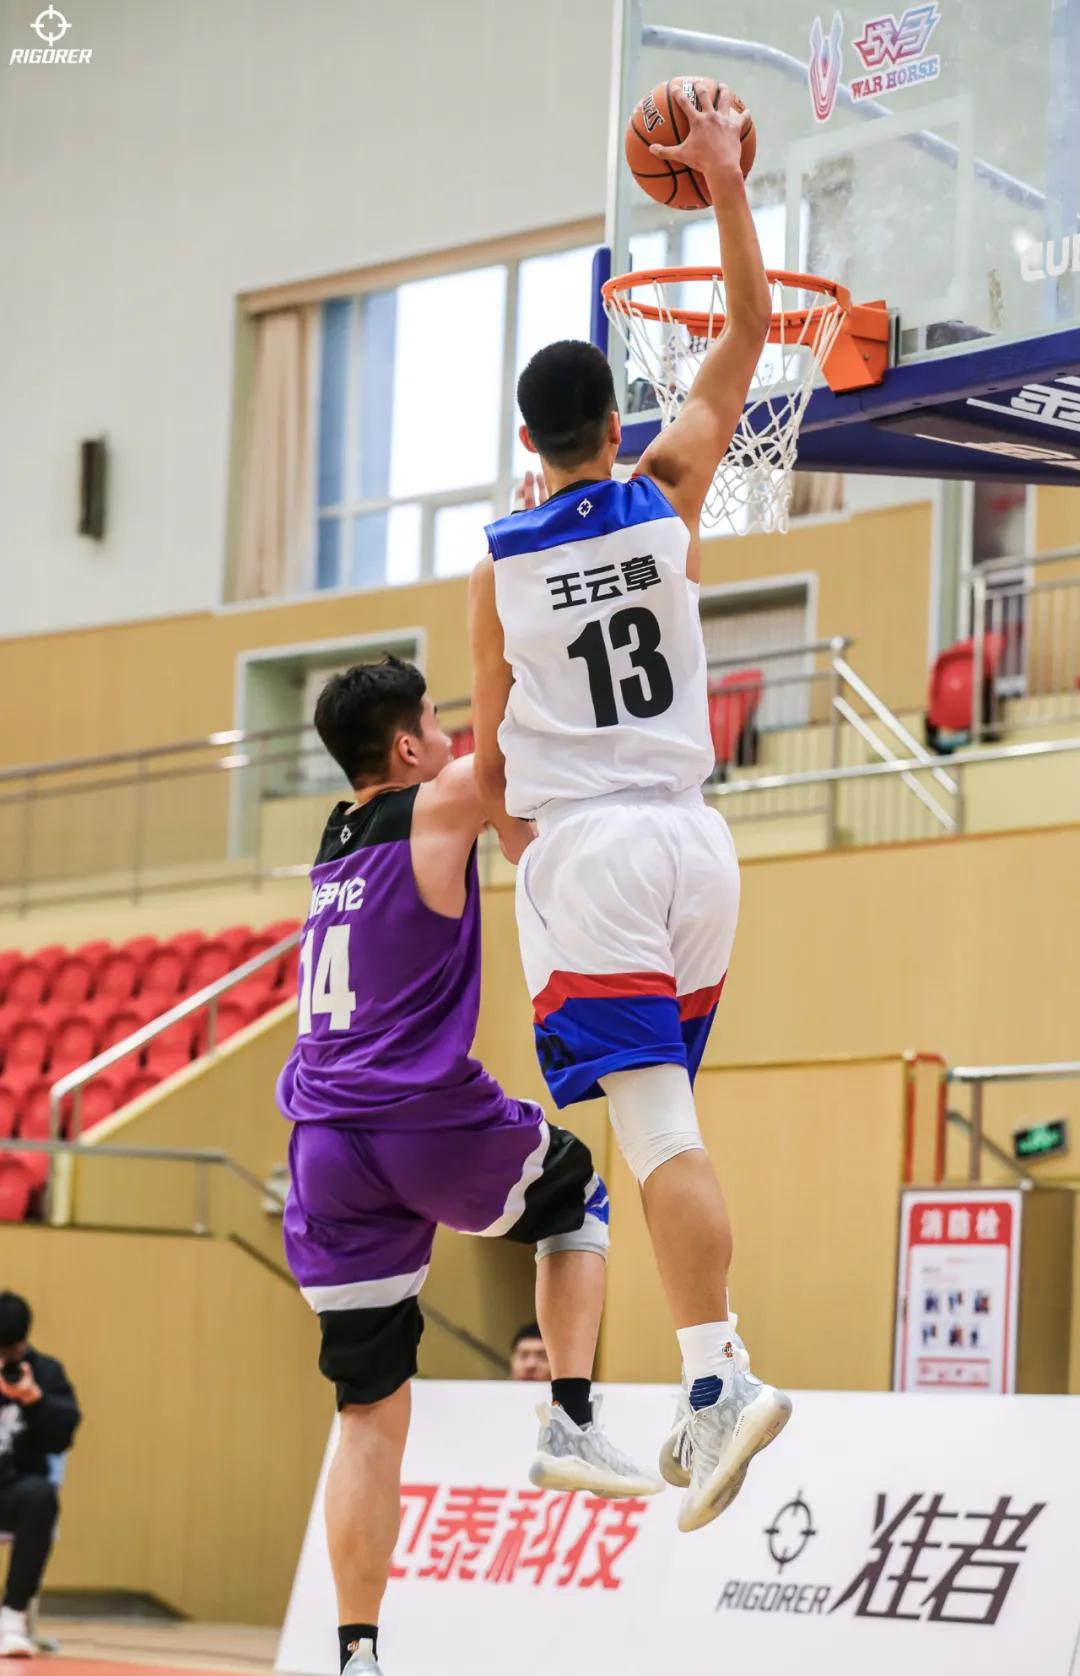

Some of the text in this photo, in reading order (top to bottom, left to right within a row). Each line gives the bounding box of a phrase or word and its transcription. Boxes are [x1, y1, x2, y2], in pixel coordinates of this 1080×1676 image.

[851, 58, 938, 99] WAR HORSE
[545, 554, 662, 611] 王云章
[566, 606, 674, 729] 13
[308, 876, 367, 920] 伊伦
[298, 923, 357, 1036] 14
[716, 1579, 832, 1614] RIGORER
